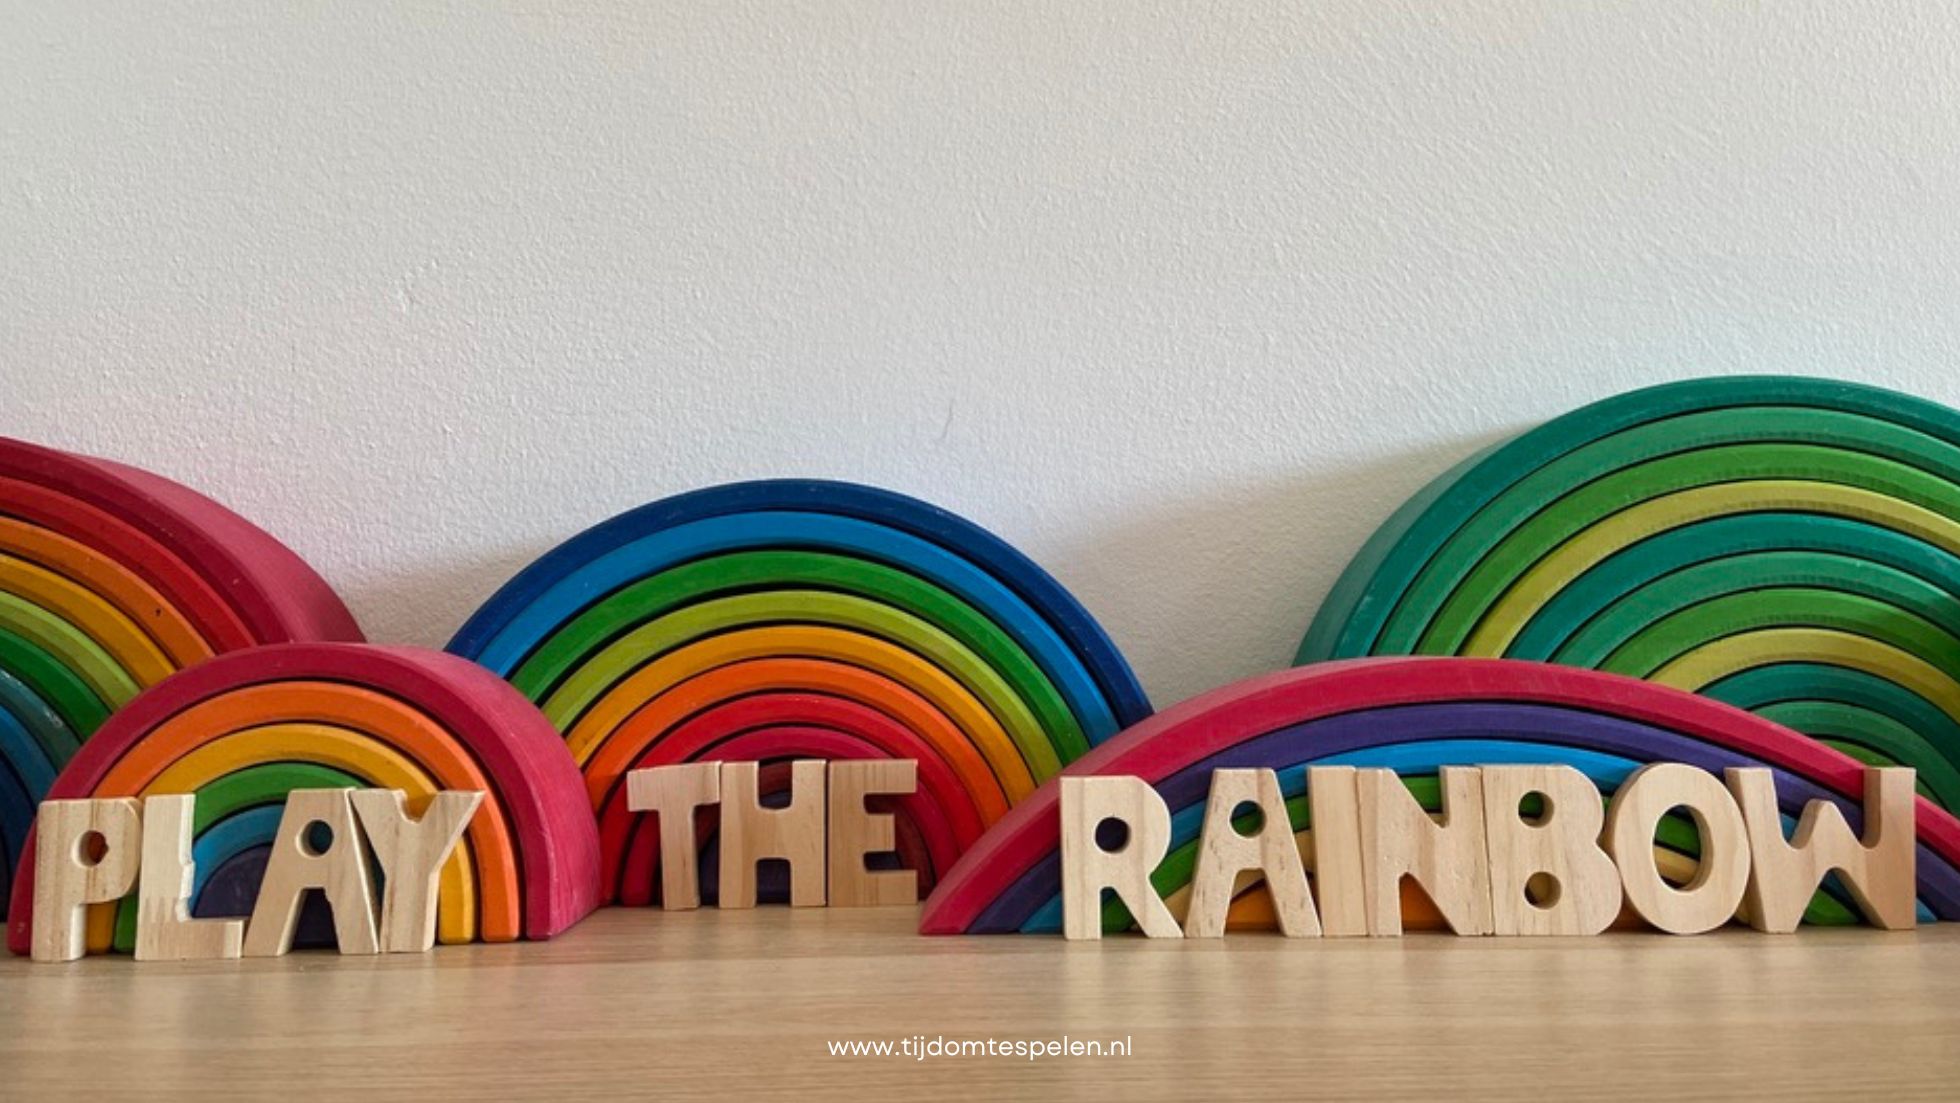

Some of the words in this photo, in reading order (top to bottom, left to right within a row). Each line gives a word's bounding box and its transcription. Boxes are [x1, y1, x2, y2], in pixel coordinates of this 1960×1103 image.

[31, 787, 486, 961] PLAY
[626, 759, 919, 911] THE
[1059, 762, 1917, 941] RAINBOW
